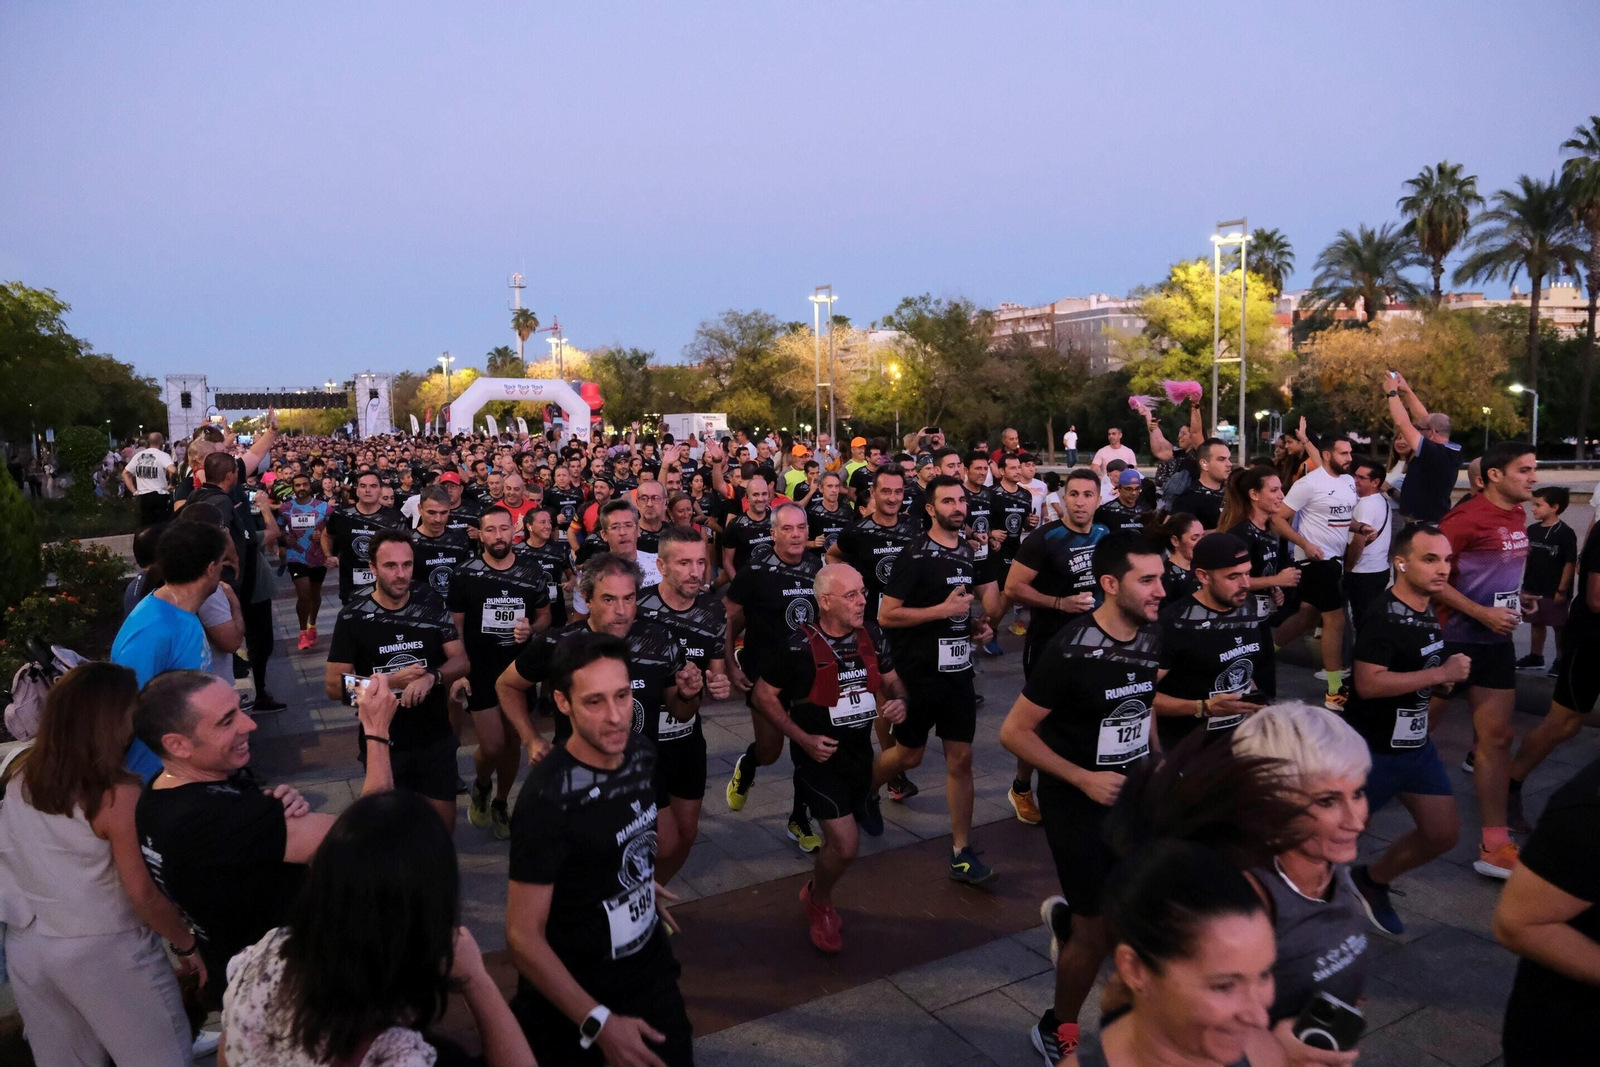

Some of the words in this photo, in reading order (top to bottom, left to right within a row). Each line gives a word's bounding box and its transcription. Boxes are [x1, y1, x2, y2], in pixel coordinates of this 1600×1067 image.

[1502, 541, 1513, 551] 36
[426, 557, 457, 566] RUNMONES
[486, 597, 524, 605] RUNMONES
[495, 611, 515, 622] 960
[379, 641, 424, 655] RUNMONES
[1219, 643, 1260, 663] RUNMONES
[1105, 681, 1153, 701] RUNMONES
[1117, 723, 1142, 743] 1212
[629, 888, 652, 922] 599
